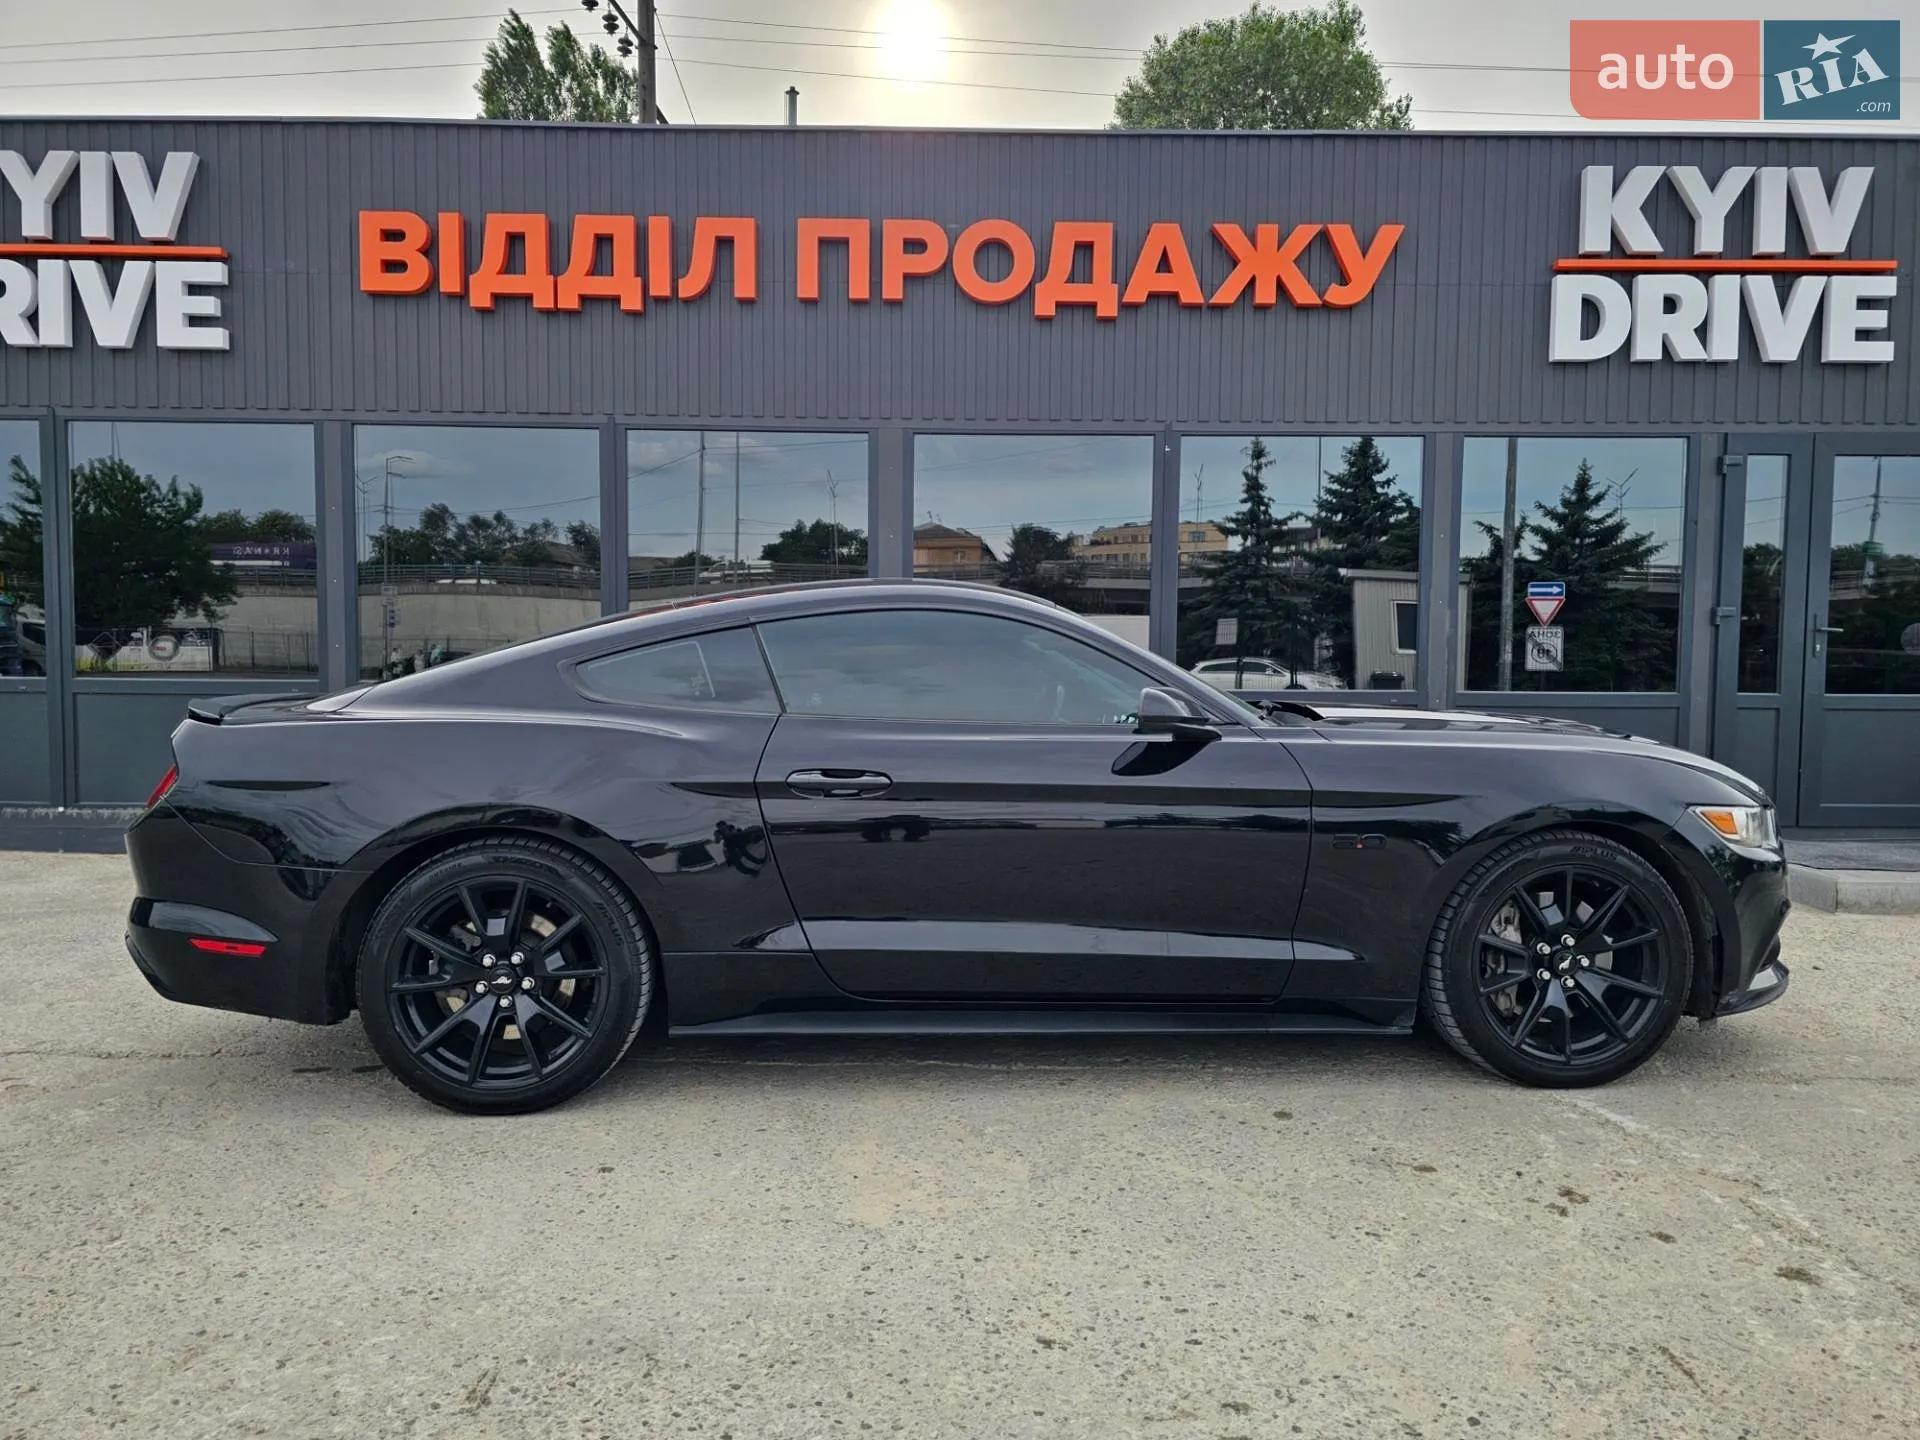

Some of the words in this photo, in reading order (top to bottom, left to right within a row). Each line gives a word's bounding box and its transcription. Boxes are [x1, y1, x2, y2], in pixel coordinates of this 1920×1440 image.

[1579, 165, 1875, 256] KYIV
[359, 210, 760, 313] ВІДДІЛ
[797, 218, 1406, 320] ПРОДАЖУ
[1549, 274, 1898, 364] DRIVE
